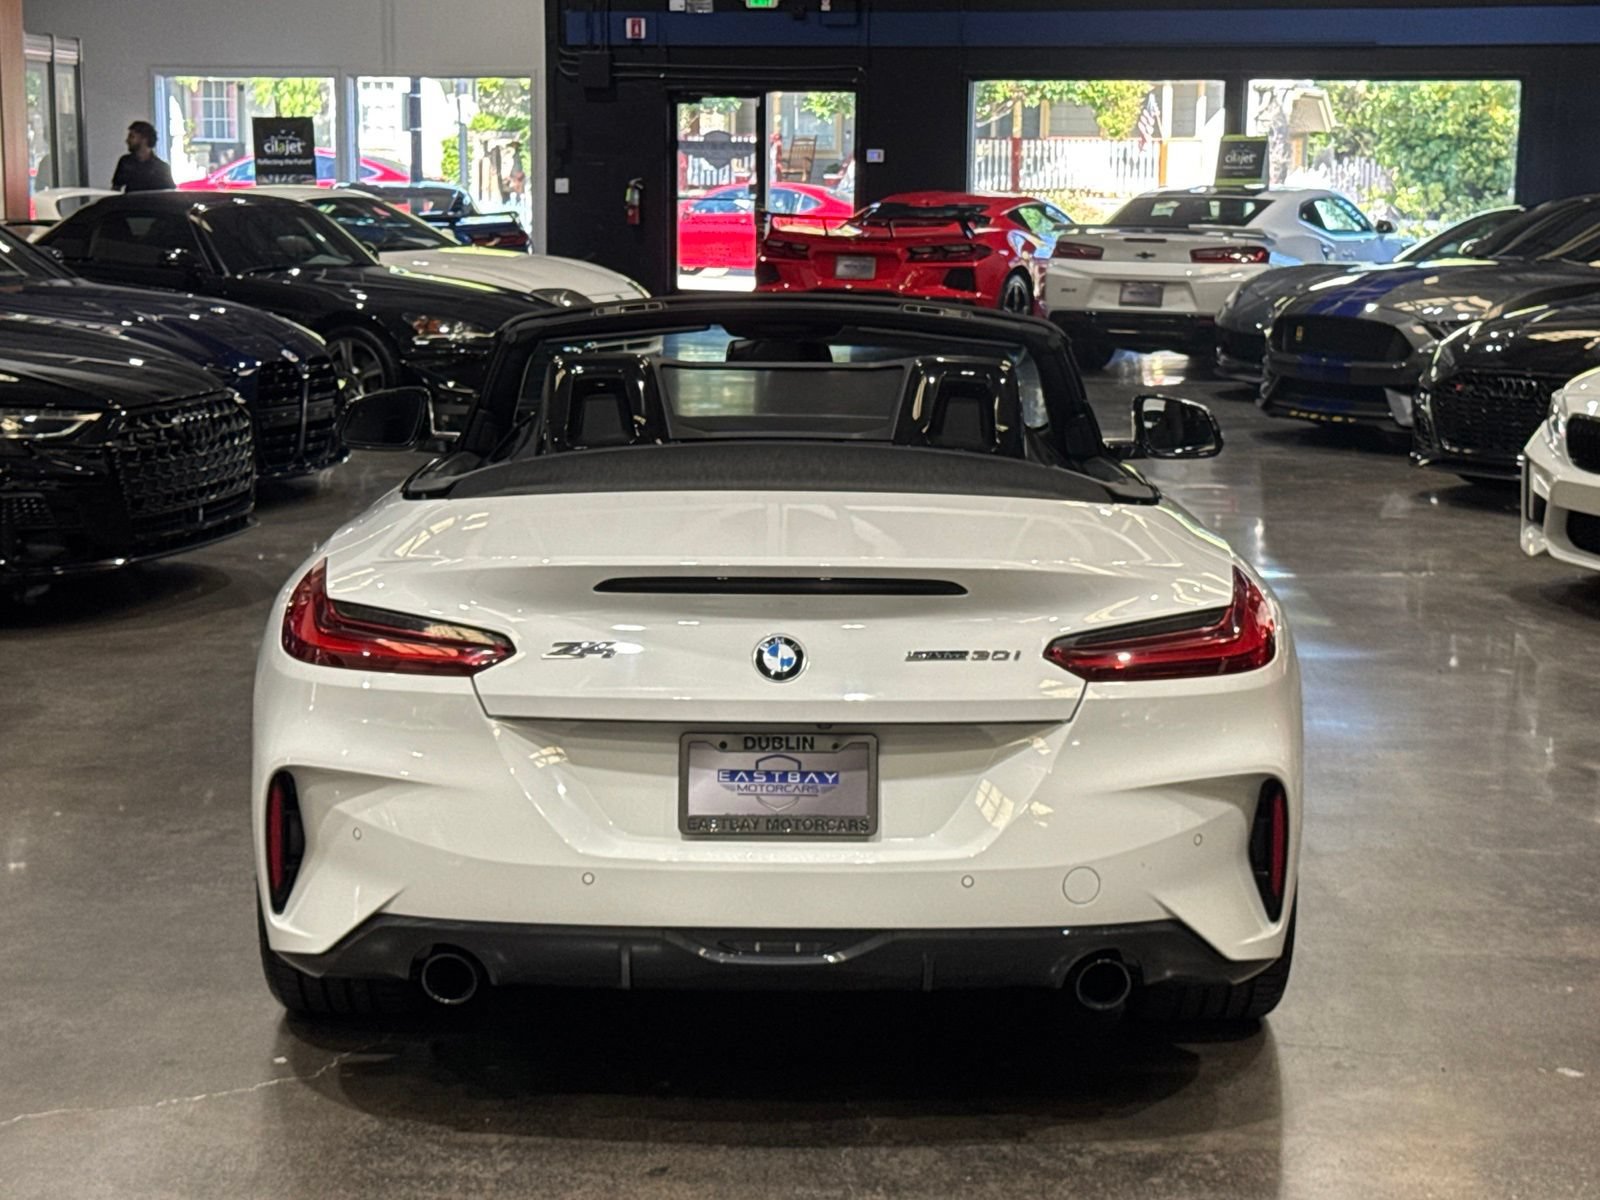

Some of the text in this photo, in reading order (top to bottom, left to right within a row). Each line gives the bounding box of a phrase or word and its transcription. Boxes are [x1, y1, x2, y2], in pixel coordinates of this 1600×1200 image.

[263, 135, 303, 156] cilajet
[743, 736, 815, 751] DUBLIN
[718, 771, 838, 784] EASTBAY
[736, 784, 820, 793] MOTORCARS
[687, 817, 870, 833] EASTBAY MOTORCARS
